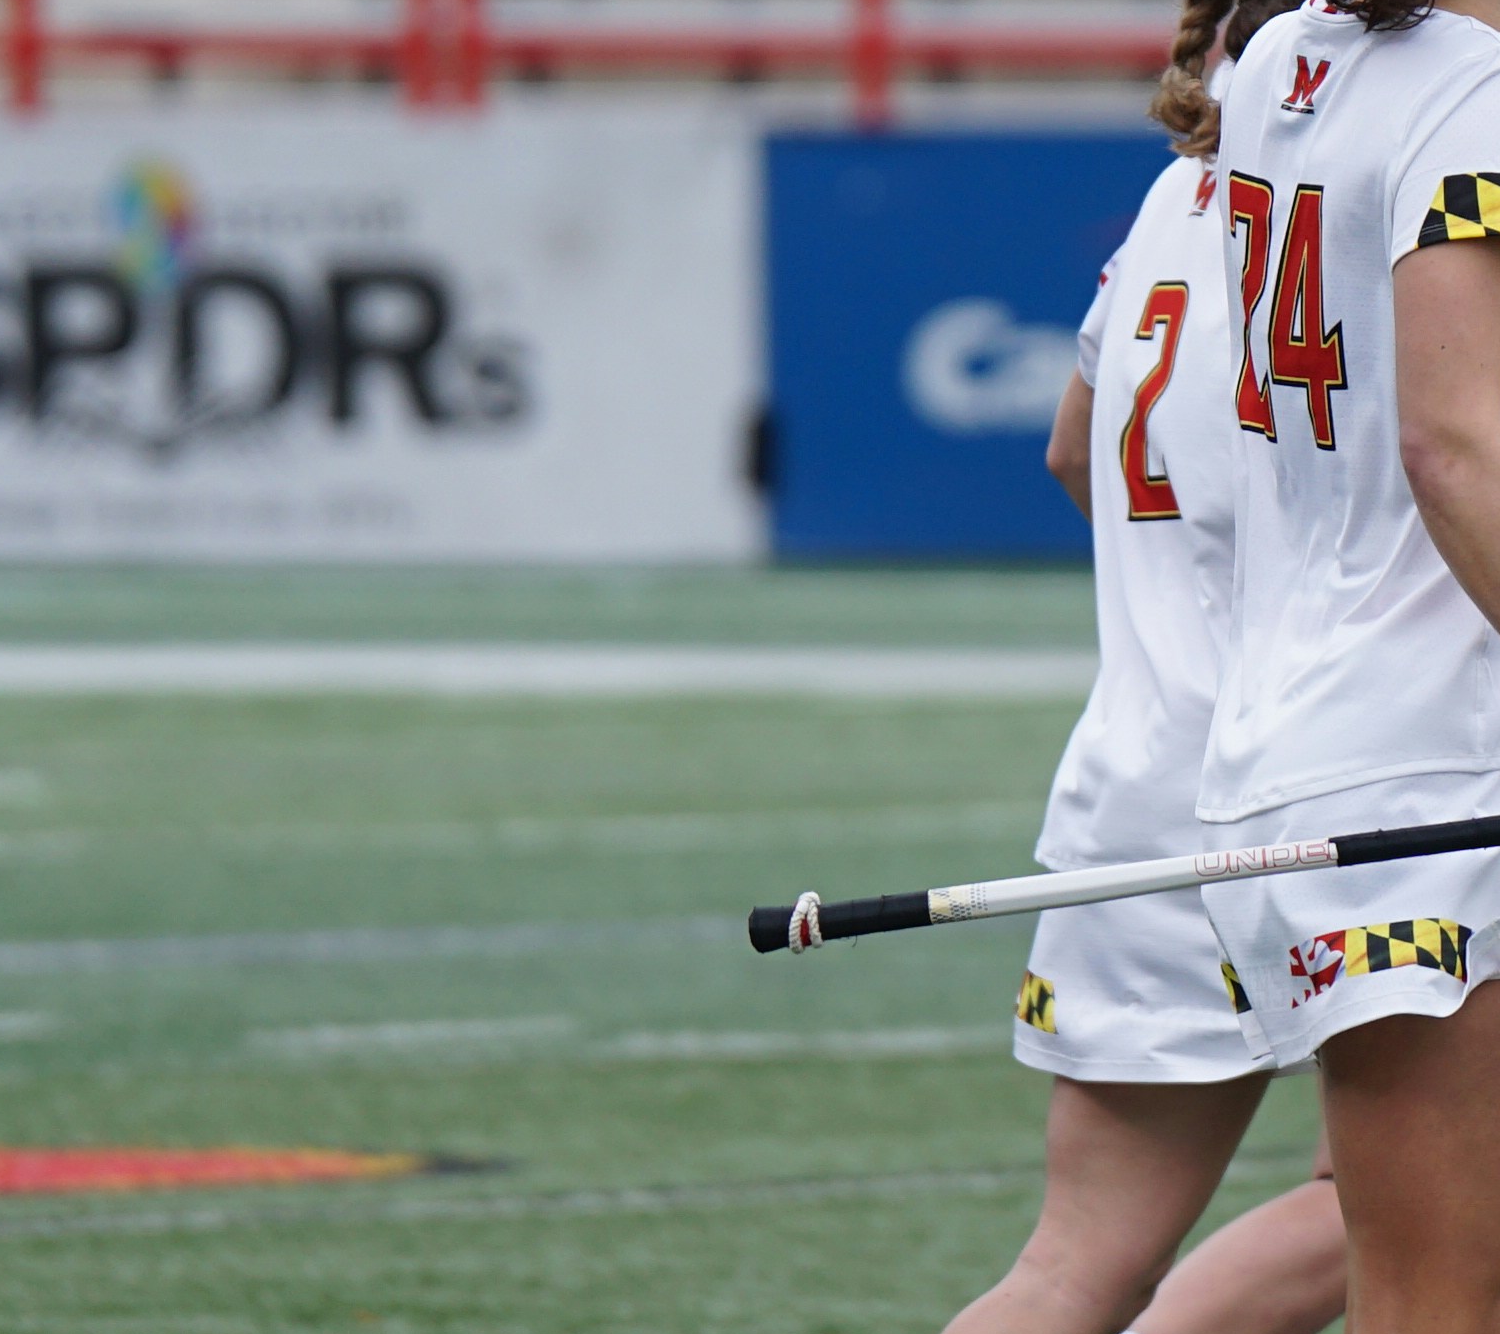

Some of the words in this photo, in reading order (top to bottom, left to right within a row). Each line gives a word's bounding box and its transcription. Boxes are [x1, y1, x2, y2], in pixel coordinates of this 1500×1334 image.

[1281, 54, 1332, 115] M
[1228, 169, 1349, 453] 24
[1120, 280, 1190, 523] 2
[1194, 838, 1339, 877] UNDE
